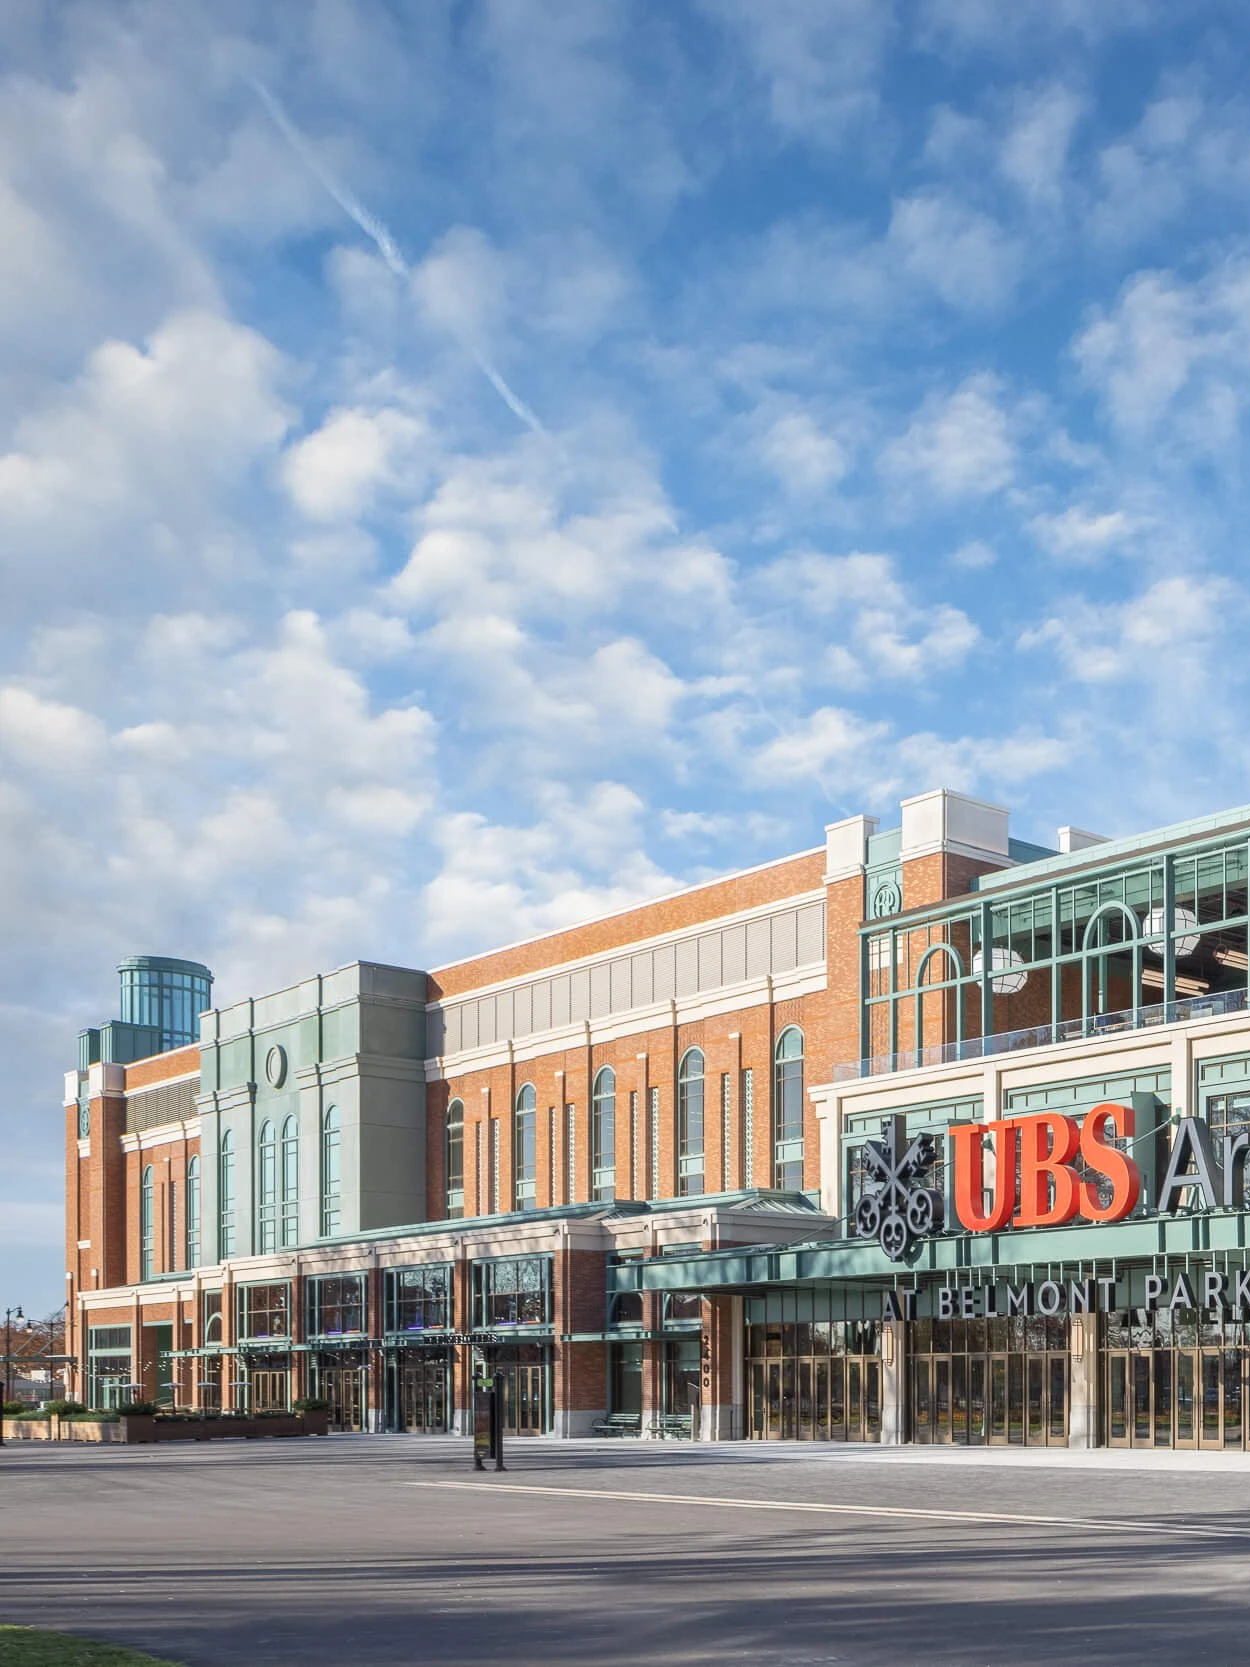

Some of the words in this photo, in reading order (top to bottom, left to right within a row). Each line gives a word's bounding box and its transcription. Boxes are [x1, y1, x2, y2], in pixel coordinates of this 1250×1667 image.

[948, 1103, 1144, 1232] UBS
[880, 1288, 920, 1321] AT
[938, 1277, 1119, 1320] BELMONT
[702, 1335, 711, 1388] 2400
